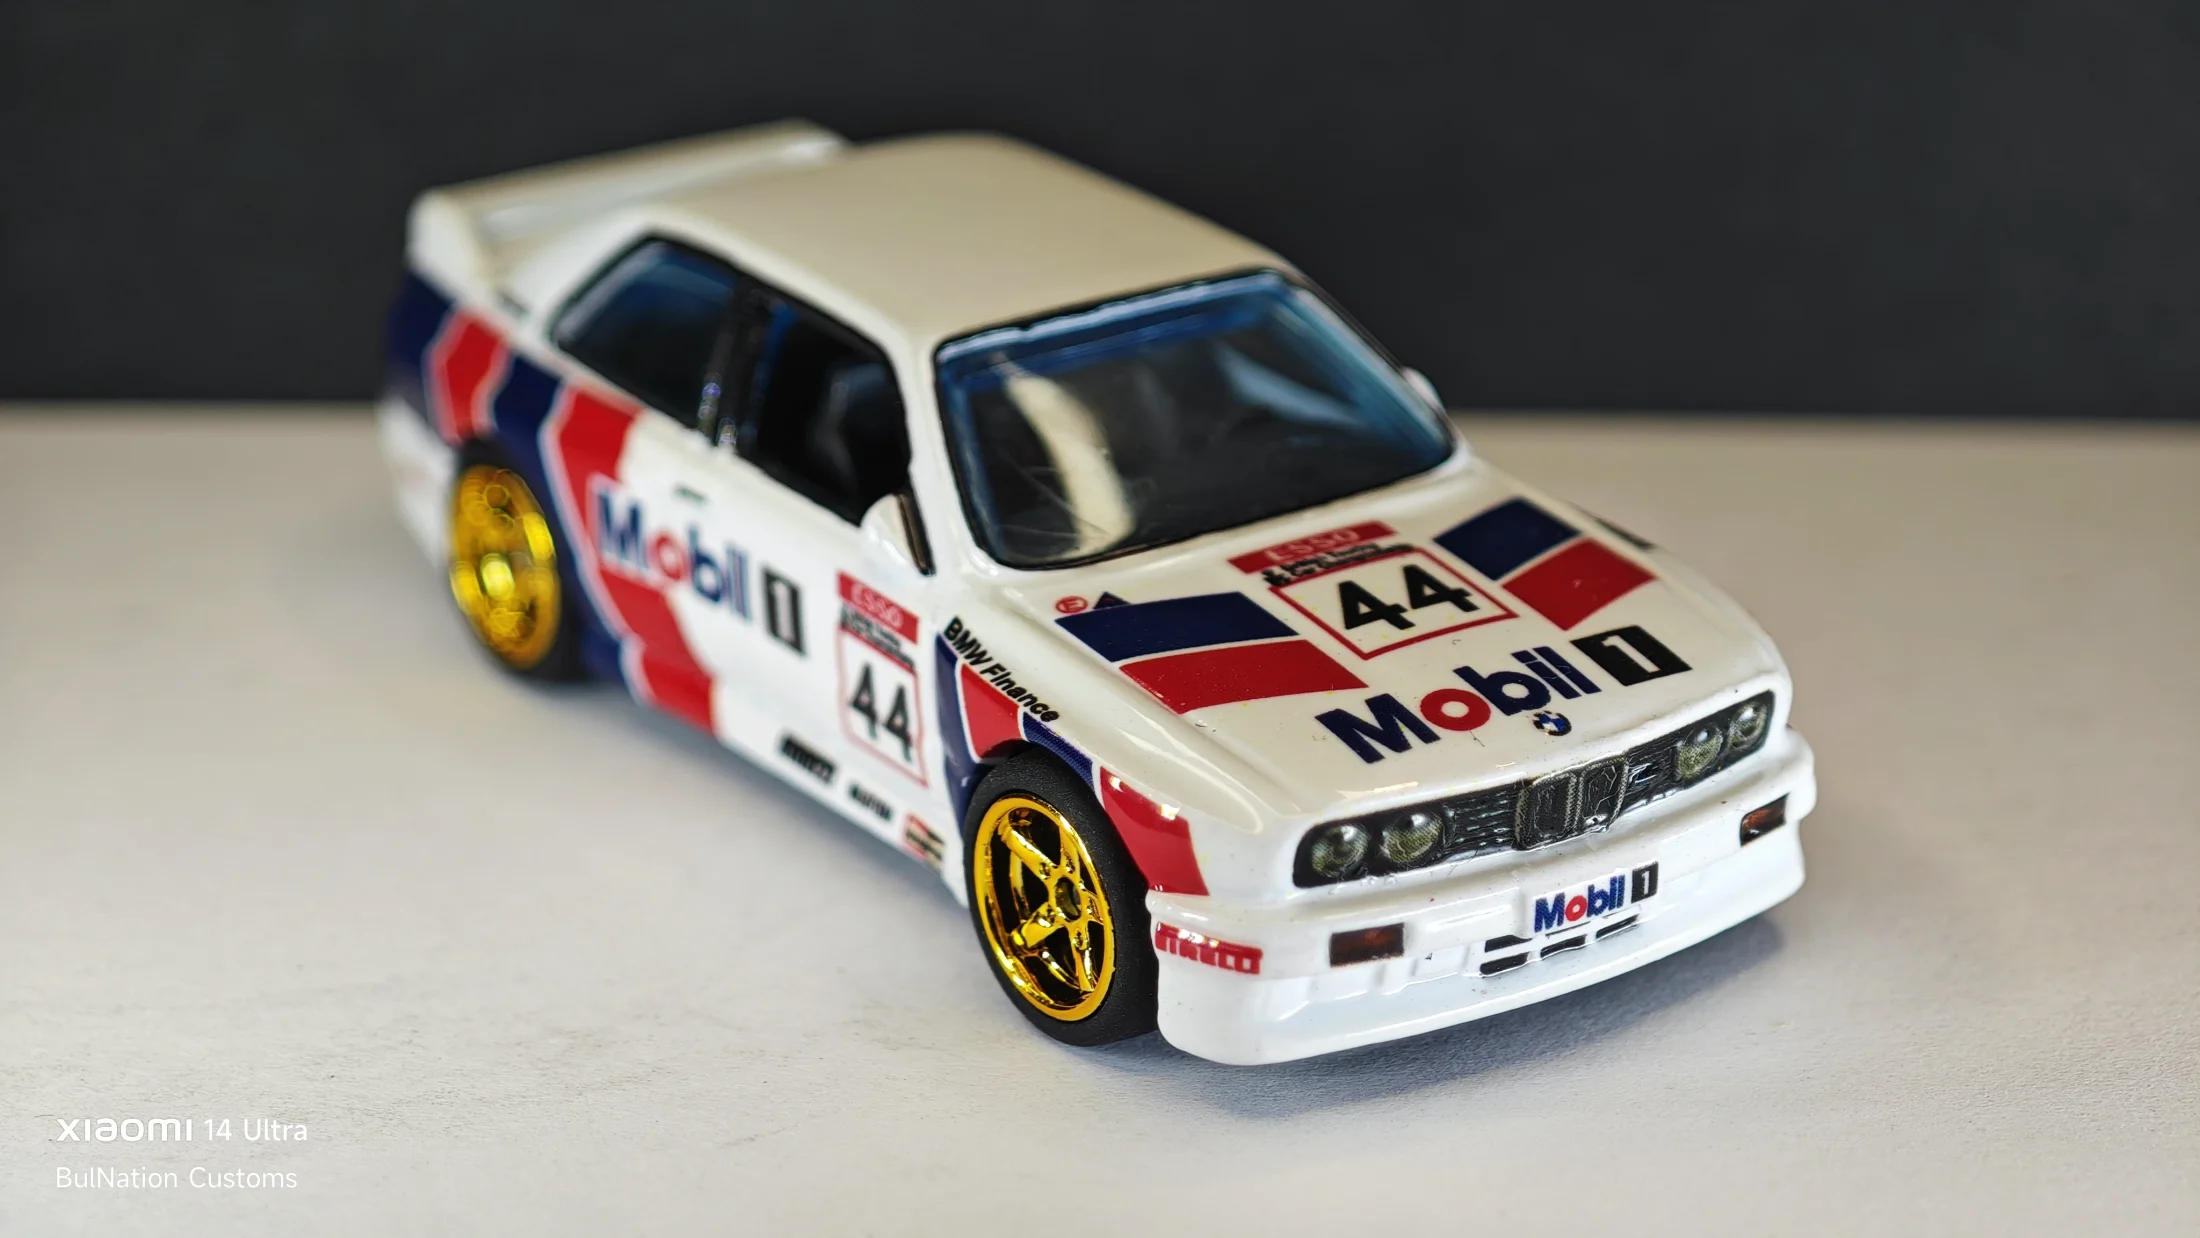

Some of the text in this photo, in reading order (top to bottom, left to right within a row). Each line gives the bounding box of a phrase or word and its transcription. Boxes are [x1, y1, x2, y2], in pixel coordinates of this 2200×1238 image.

[600, 490, 751, 622] Mobil
[1336, 562, 1480, 631] 44
[848, 661, 912, 763] 44
[943, 615, 1060, 723] BMW Finance
[1315, 645, 1602, 764] Mobil
[1534, 874, 1626, 933] Mobil
